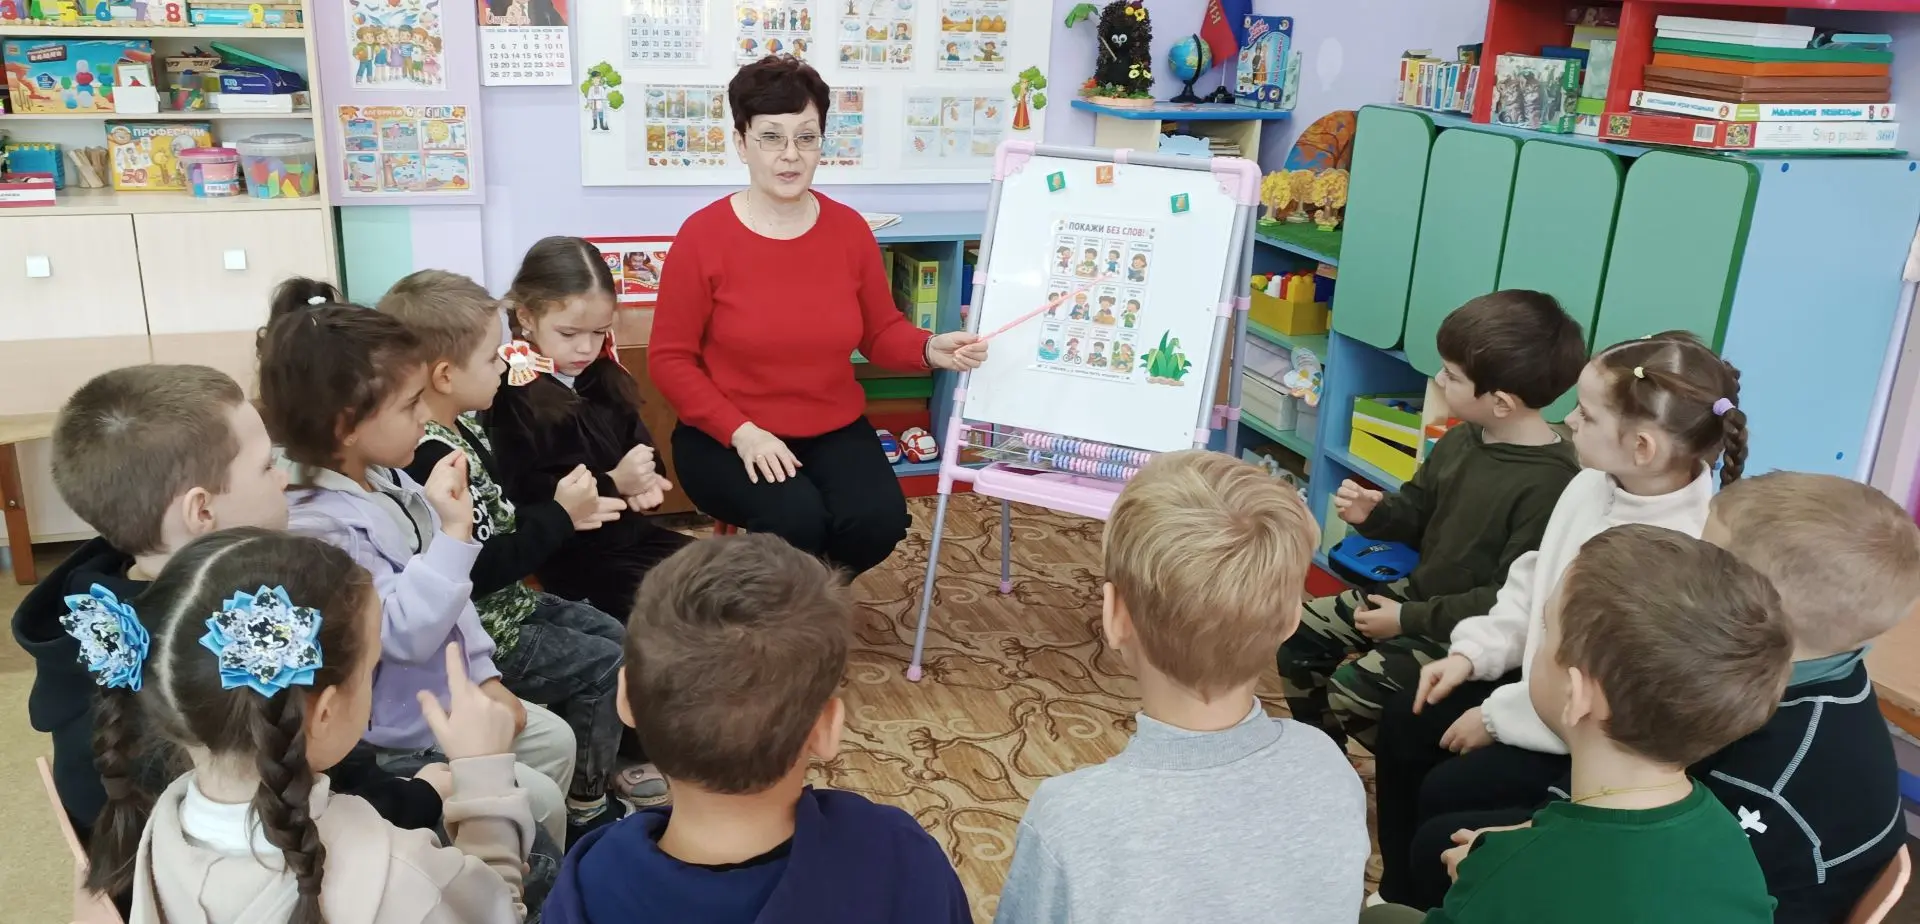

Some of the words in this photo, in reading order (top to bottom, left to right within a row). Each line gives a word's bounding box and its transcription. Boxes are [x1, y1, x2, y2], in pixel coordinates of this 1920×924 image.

[165, 3, 181, 22] 8
[133, 127, 205, 137] ПРОФЕССИИ
[121, 168, 148, 184] 50
[1068, 221, 1105, 233] ПОКАЖИ
[1106, 225, 1120, 235] БЕЗ
[1122, 227, 1145, 237] СЛОВ!
